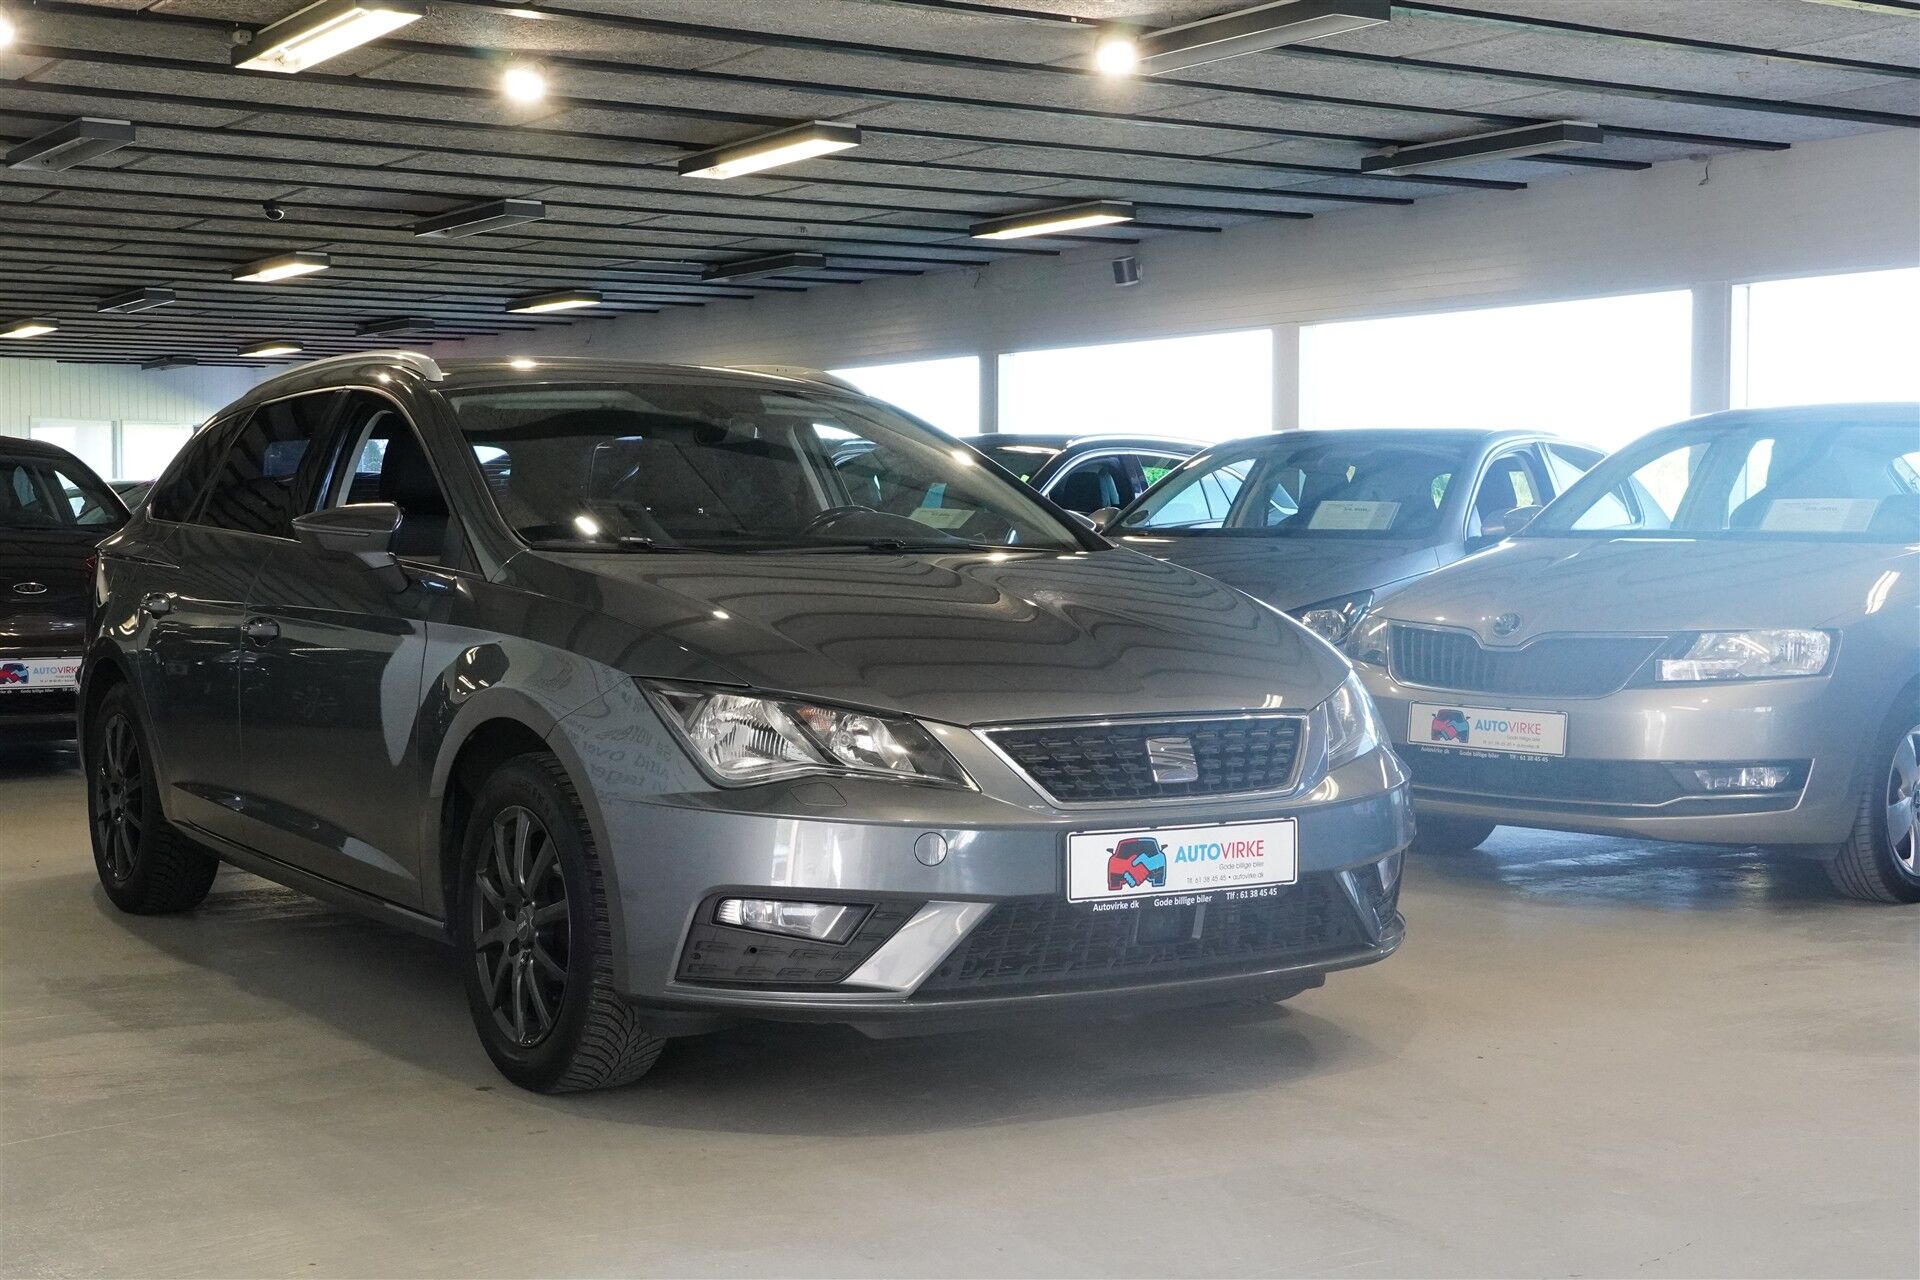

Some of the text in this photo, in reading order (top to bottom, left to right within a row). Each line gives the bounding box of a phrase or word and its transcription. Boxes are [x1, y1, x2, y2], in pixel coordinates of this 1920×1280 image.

[1475, 720, 1541, 735] AUTOVIRKE
[1174, 840, 1264, 863] AUTOVIRKE
[1219, 863, 1235, 871] Gode
[1093, 901, 1129, 911] Autovirke
[1154, 898, 1173, 907] Gode
[1174, 896, 1195, 906] billige
[1196, 894, 1212, 903] biler
[1240, 890, 1248, 898] 61
[1249, 889, 1258, 898] 38
[1259, 888, 1268, 897] 45
[1269, 887, 1278, 896] 45
